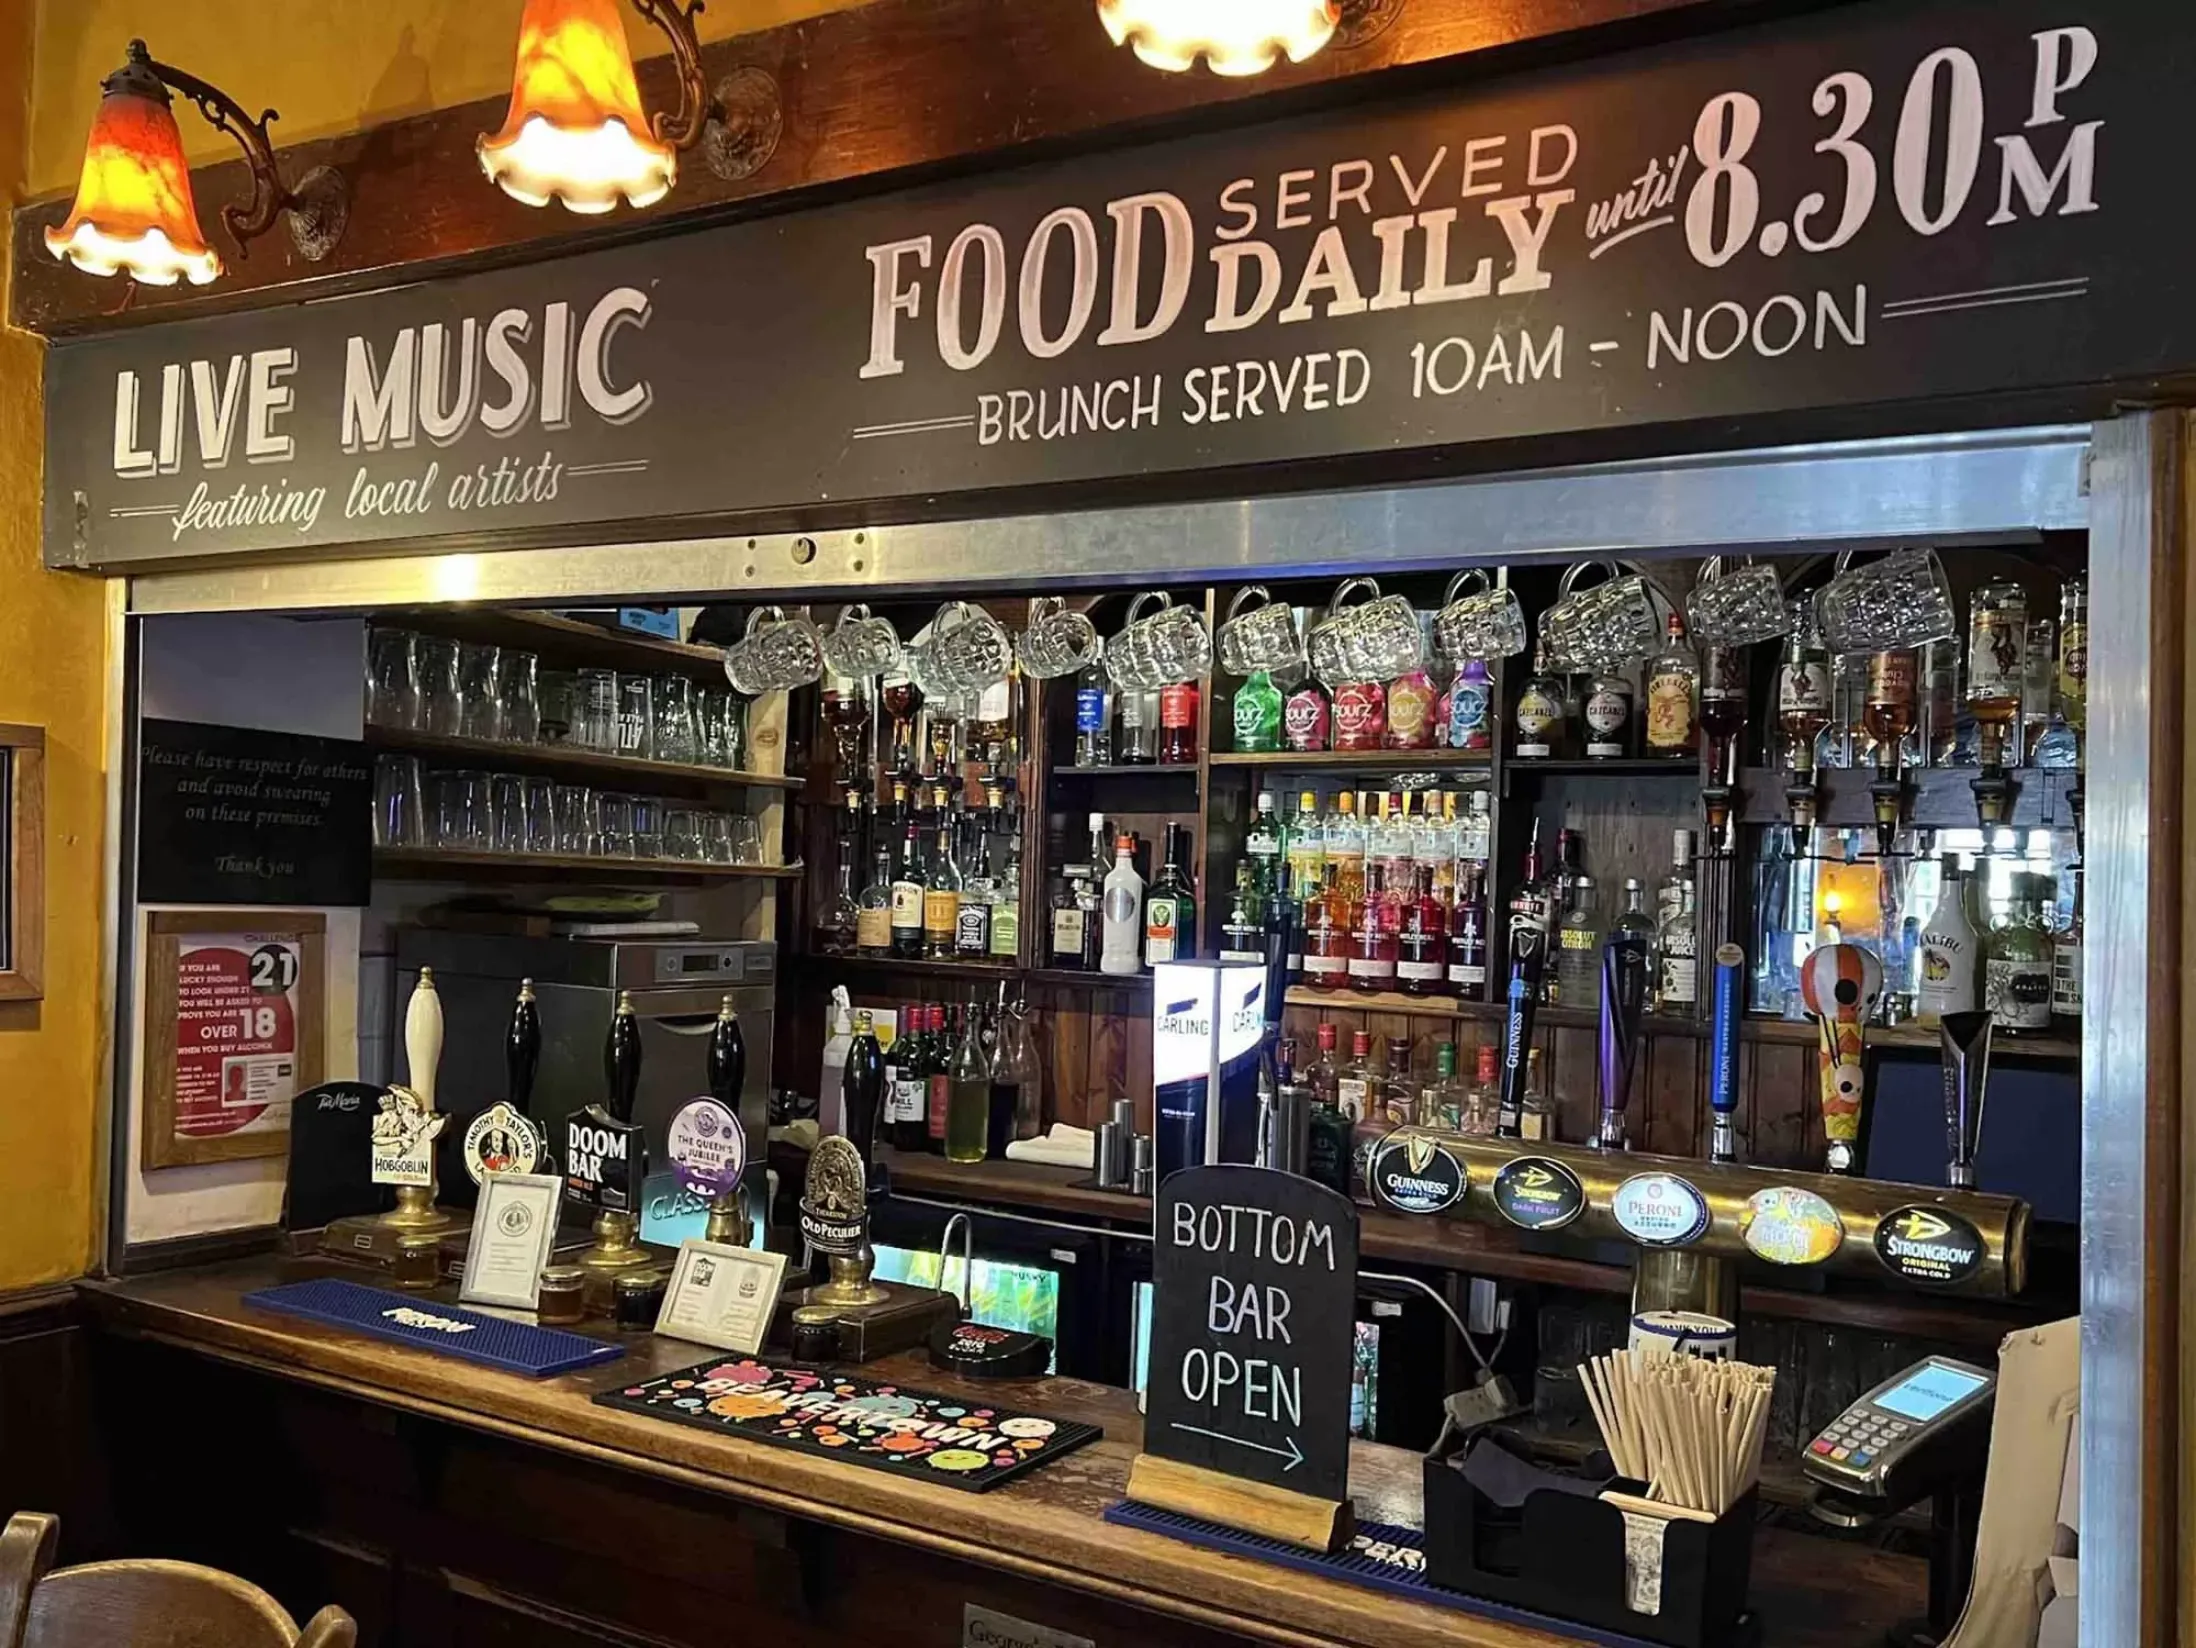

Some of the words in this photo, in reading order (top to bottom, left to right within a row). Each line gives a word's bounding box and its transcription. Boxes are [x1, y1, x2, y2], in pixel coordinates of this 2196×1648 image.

[1586, 144, 1688, 239] until
[1685, 46, 1983, 268] 8.30
[1216, 124, 1578, 239] SERVED
[1205, 190, 1574, 333] DAILY
[859, 192, 1193, 378] FOOD
[113, 347, 298, 478] LIVE
[341, 287, 652, 455] MUSIC
[977, 373, 1161, 445] BRUNCH
[1182, 349, 1370, 424] SERVED
[1410, 326, 1564, 398] 10AM
[1648, 284, 1866, 370] NOON
[171, 476, 325, 541] featuring
[344, 461, 438, 519] local
[448, 451, 564, 510] artists
[194, 750, 232, 769] have
[239, 757, 291, 778] respect
[292, 757, 319, 782] for
[322, 762, 370, 781] others
[177, 777, 209, 796] and
[213, 781, 260, 797] avoid
[264, 785, 332, 806] swearing
[185, 806, 206, 821] on
[211, 802, 250, 823] these
[213, 854, 264, 876] Thank
[262, 860, 295, 878] you
[252, 951, 293, 987] 21
[200, 1025, 237, 1039] OVER
[240, 1007, 277, 1039] 18
[1157, 1016, 1209, 1036] CARLING
[1507, 1012, 1523, 1068] GUINNESS
[1719, 1055, 1730, 1095] PERONI
[467, 1115, 494, 1151] TIMOTHY
[505, 1116, 534, 1159] TAYLOR'S
[569, 1121, 627, 1160] DOOM
[677, 1135, 694, 1146] THE
[696, 1138, 734, 1154] QUEEN'S
[375, 1158, 428, 1174] HOBGOBLIN
[568, 1149, 604, 1183] BAR
[688, 1148, 720, 1162] JUBILEE
[1387, 1173, 1449, 1196] GUINNESS
[1628, 1200, 1684, 1217] PERONI
[821, 1222, 861, 1238] PECULIER
[1173, 1203, 1335, 1271] BOTTOM
[1887, 1235, 1973, 1265] STRONGBOW
[1902, 1257, 1951, 1271] ORIGINAL
[1902, 1266, 1927, 1276] EXTRA
[1208, 1276, 1292, 1344] BAR
[1181, 1348, 1300, 1427] OPEN
[695, 1378, 1008, 1451] BEAVERTOWN
